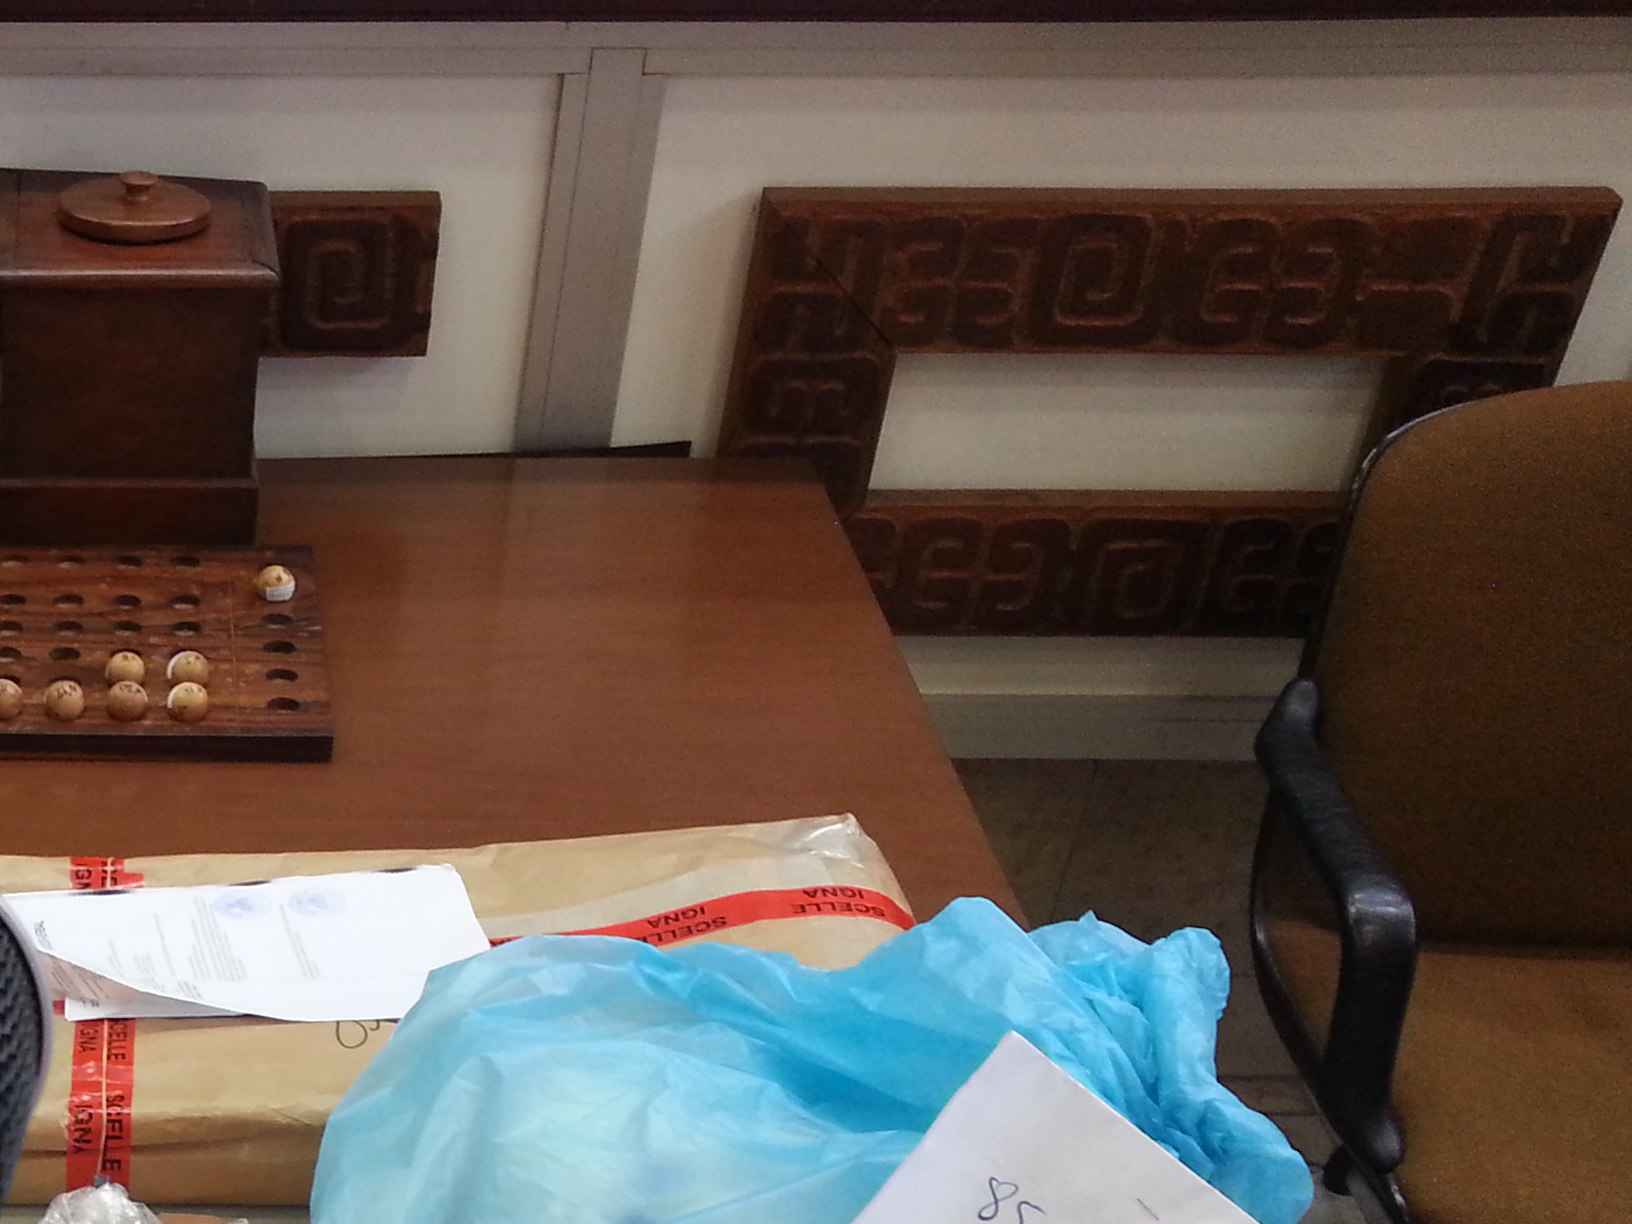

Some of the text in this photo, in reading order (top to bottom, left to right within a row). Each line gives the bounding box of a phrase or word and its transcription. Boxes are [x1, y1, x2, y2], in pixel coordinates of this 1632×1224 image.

[802, 886, 864, 899] IGNA
[647, 906, 705, 928] IGNA
[791, 901, 885, 917] SCELLE
[73, 1105, 93, 1154] IGNA
